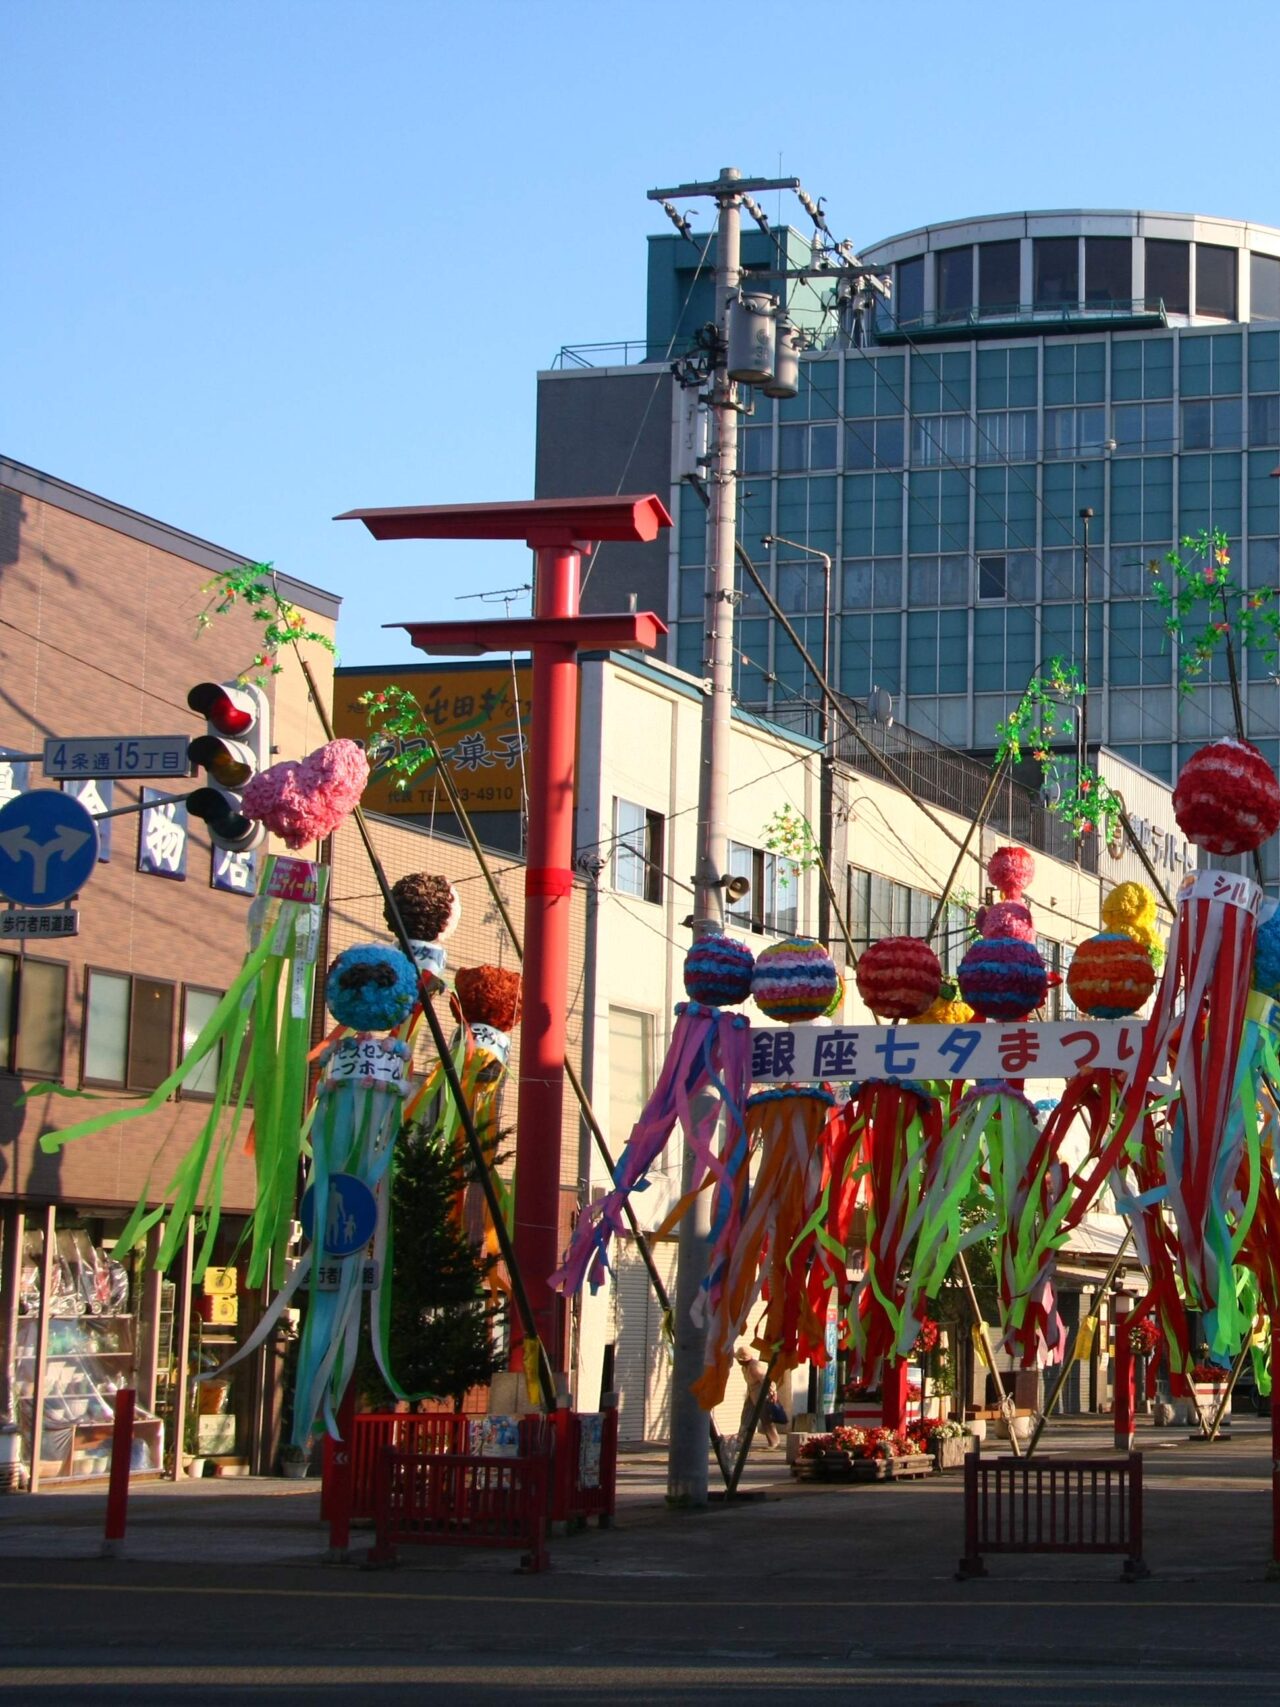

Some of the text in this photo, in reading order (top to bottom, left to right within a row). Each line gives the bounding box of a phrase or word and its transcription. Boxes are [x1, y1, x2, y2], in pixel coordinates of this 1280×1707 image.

[53, 742, 180, 771] 4条通15丁目
[3, 915, 76, 933] 歩行者用道路
